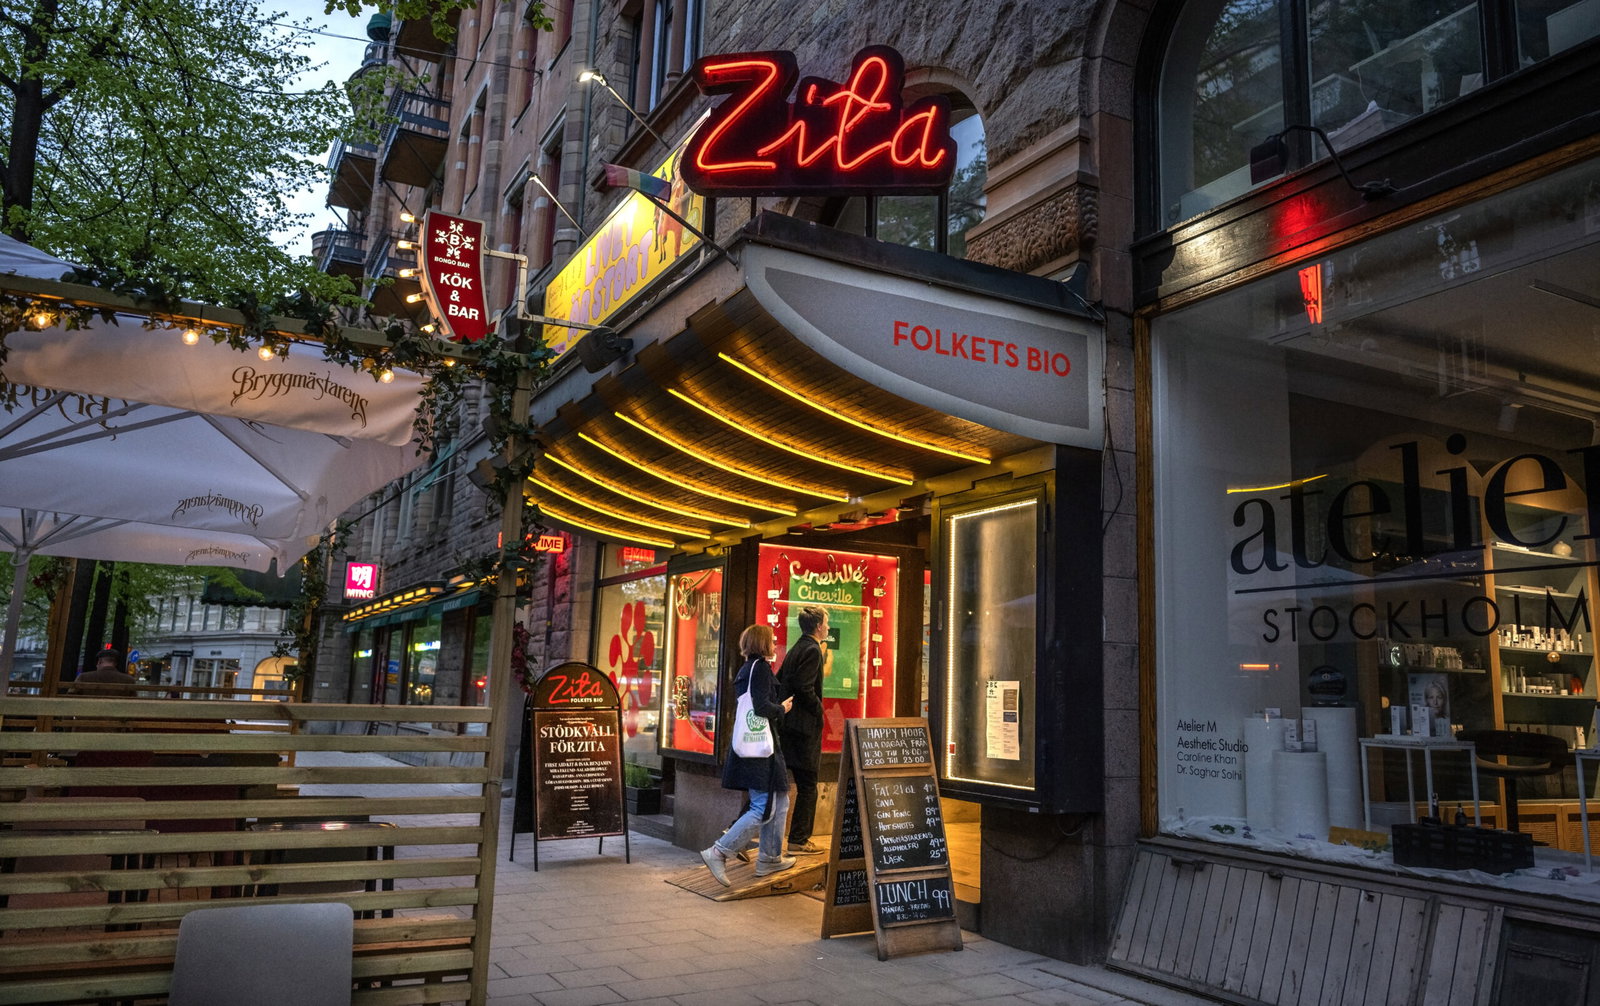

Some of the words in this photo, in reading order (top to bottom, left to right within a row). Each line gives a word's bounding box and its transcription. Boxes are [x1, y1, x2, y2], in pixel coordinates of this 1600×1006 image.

[696, 56, 946, 171] Zita
[434, 256, 457, 266] BONGO
[457, 261, 471, 269] BAR
[440, 272, 473, 290] KÖK
[592, 229, 653, 320] STORT
[450, 290, 460, 302] &
[448, 304, 479, 321] BAR
[893, 320, 1019, 367] FOLKETS
[1027, 346, 1071, 377] BIO
[230, 366, 369, 428] Bryggmästarens
[352, 565, 373, 588] 明
[790, 561, 866, 585] Cineville
[346, 588, 374, 598] MING
[798, 585, 854, 603] Cineville
[1263, 586, 1593, 643] STOCKHOLM
[548, 672, 603, 704] Zita
[540, 724, 615, 738] STÖDKVÄLL
[867, 728, 897, 738] HAPPY
[900, 727, 926, 737] HOUR
[1177, 718, 1205, 732] Atelier
[1207, 721, 1217, 732] M
[550, 739, 576, 753] FÖR
[577, 740, 606, 752] ZITA
[881, 739, 909, 748] DAGAR
[1177, 736, 1217, 751] Aesthetic
[1219, 738, 1249, 753] Studio
[1177, 751, 1212, 763] Caroline
[1214, 753, 1237, 765] Khan
[1177, 764, 1188, 774] Dr.
[1189, 765, 1220, 779] Saghar
[1221, 769, 1243, 781] Solhi
[875, 798, 895, 807] CAVA
[879, 880, 927, 904] LUNCH
